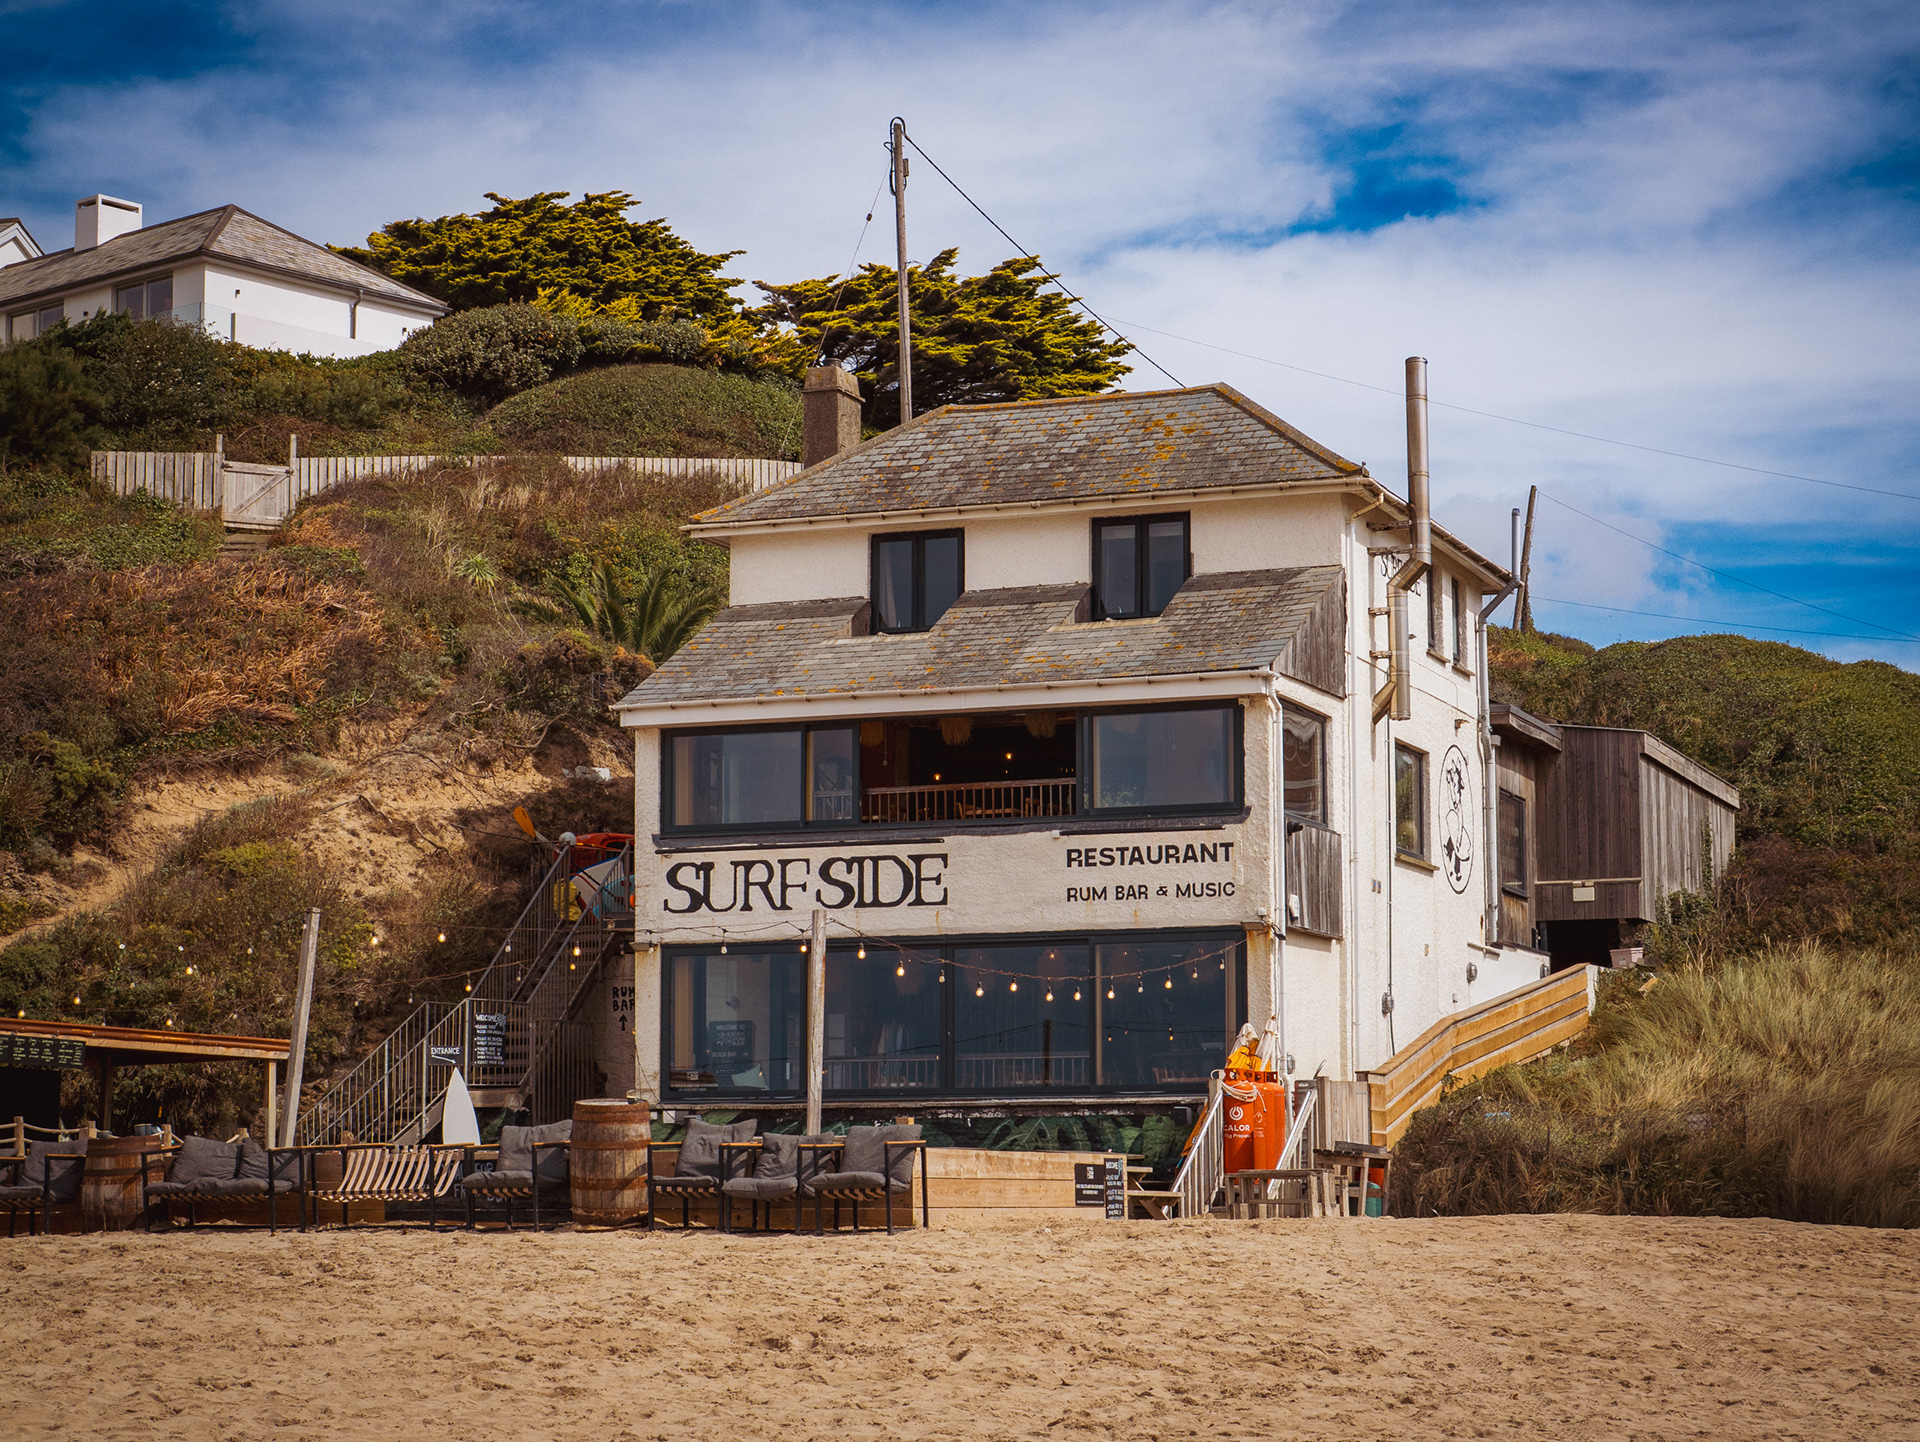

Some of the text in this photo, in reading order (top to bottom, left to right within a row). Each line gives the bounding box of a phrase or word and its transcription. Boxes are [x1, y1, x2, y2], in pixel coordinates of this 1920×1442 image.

[1066, 842, 1235, 868] RESTAURANT
[663, 853, 948, 913] SURFSIDE
[1066, 882, 1236, 902] RUM BAR & MUSIC
[475, 1013, 497, 1022] WELCOME
[430, 1047, 461, 1055] ENTRANCE
